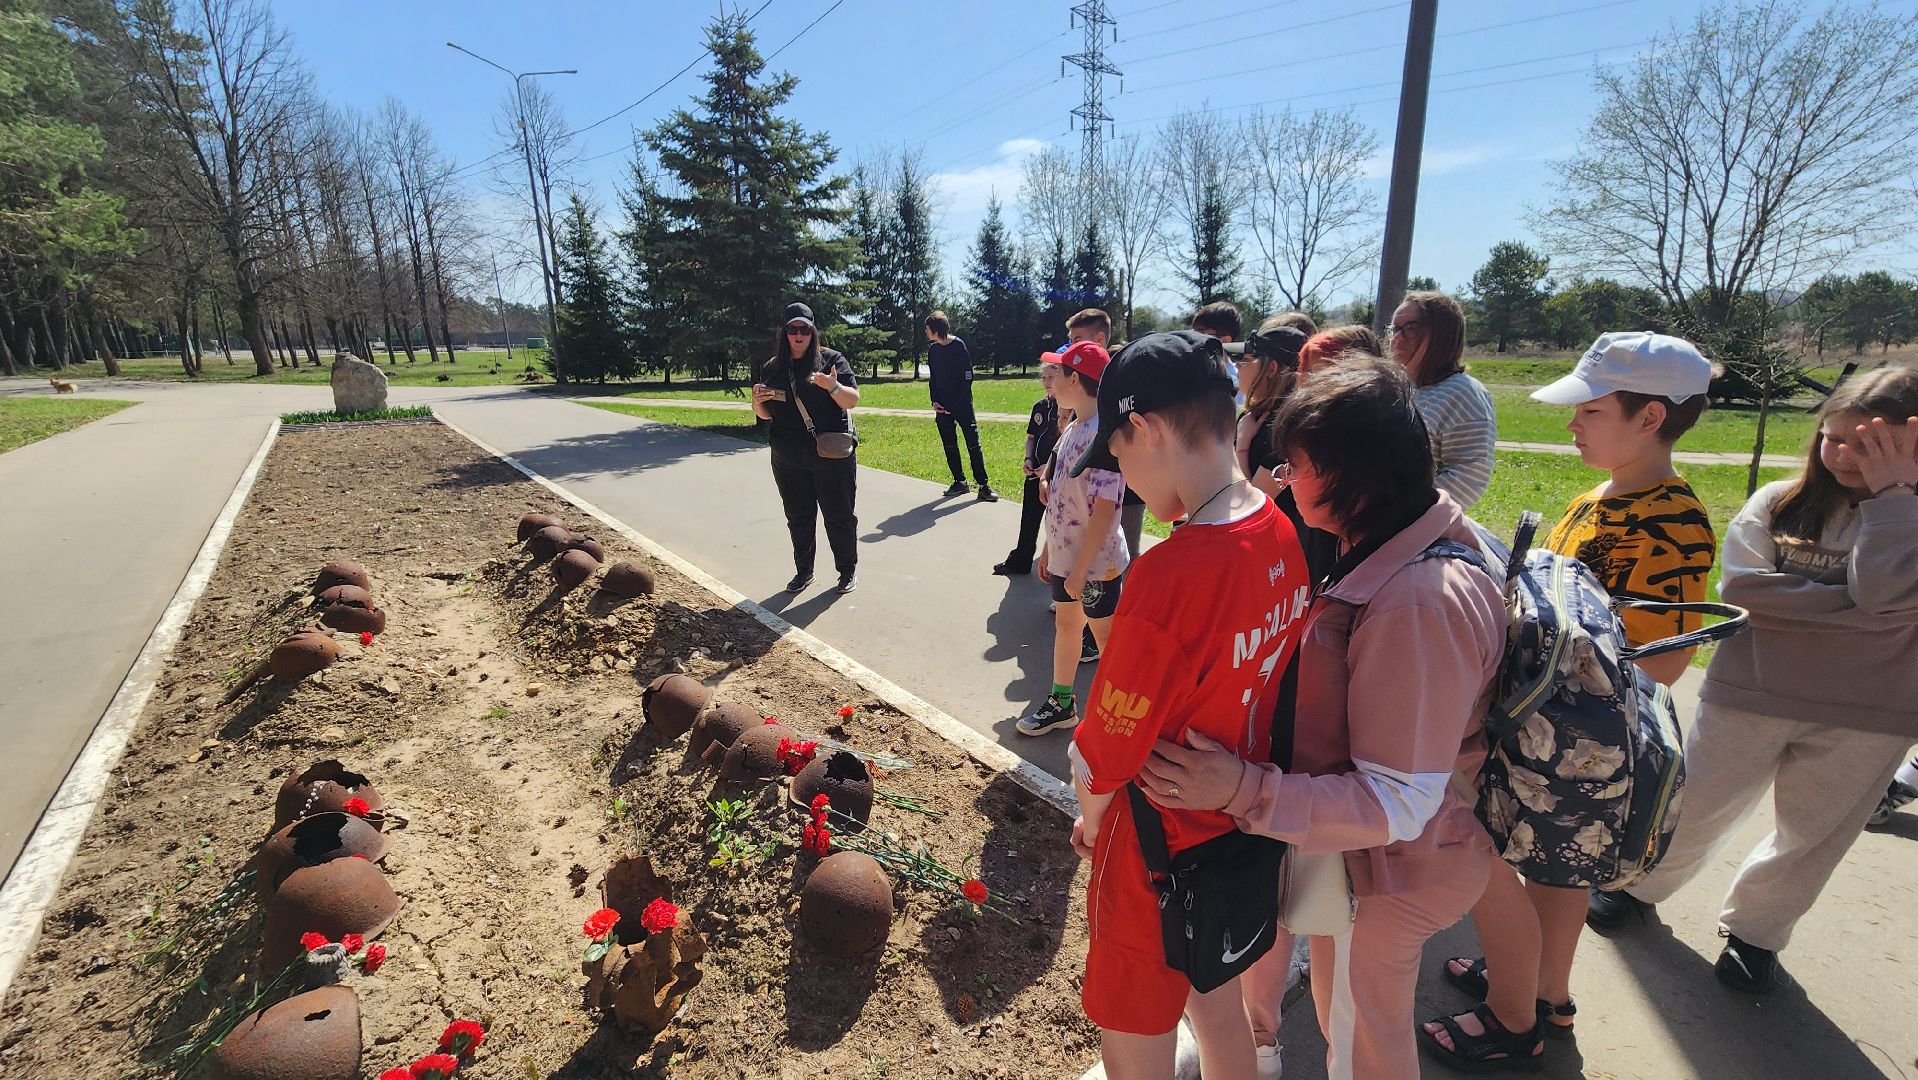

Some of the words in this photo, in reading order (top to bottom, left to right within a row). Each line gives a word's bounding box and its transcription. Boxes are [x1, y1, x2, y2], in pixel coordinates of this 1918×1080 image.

[1118, 395, 1135, 415] NIKE
[1101, 679, 1151, 720] WU
[1096, 705, 1137, 730] WESERN
[1103, 724, 1134, 737] UON
